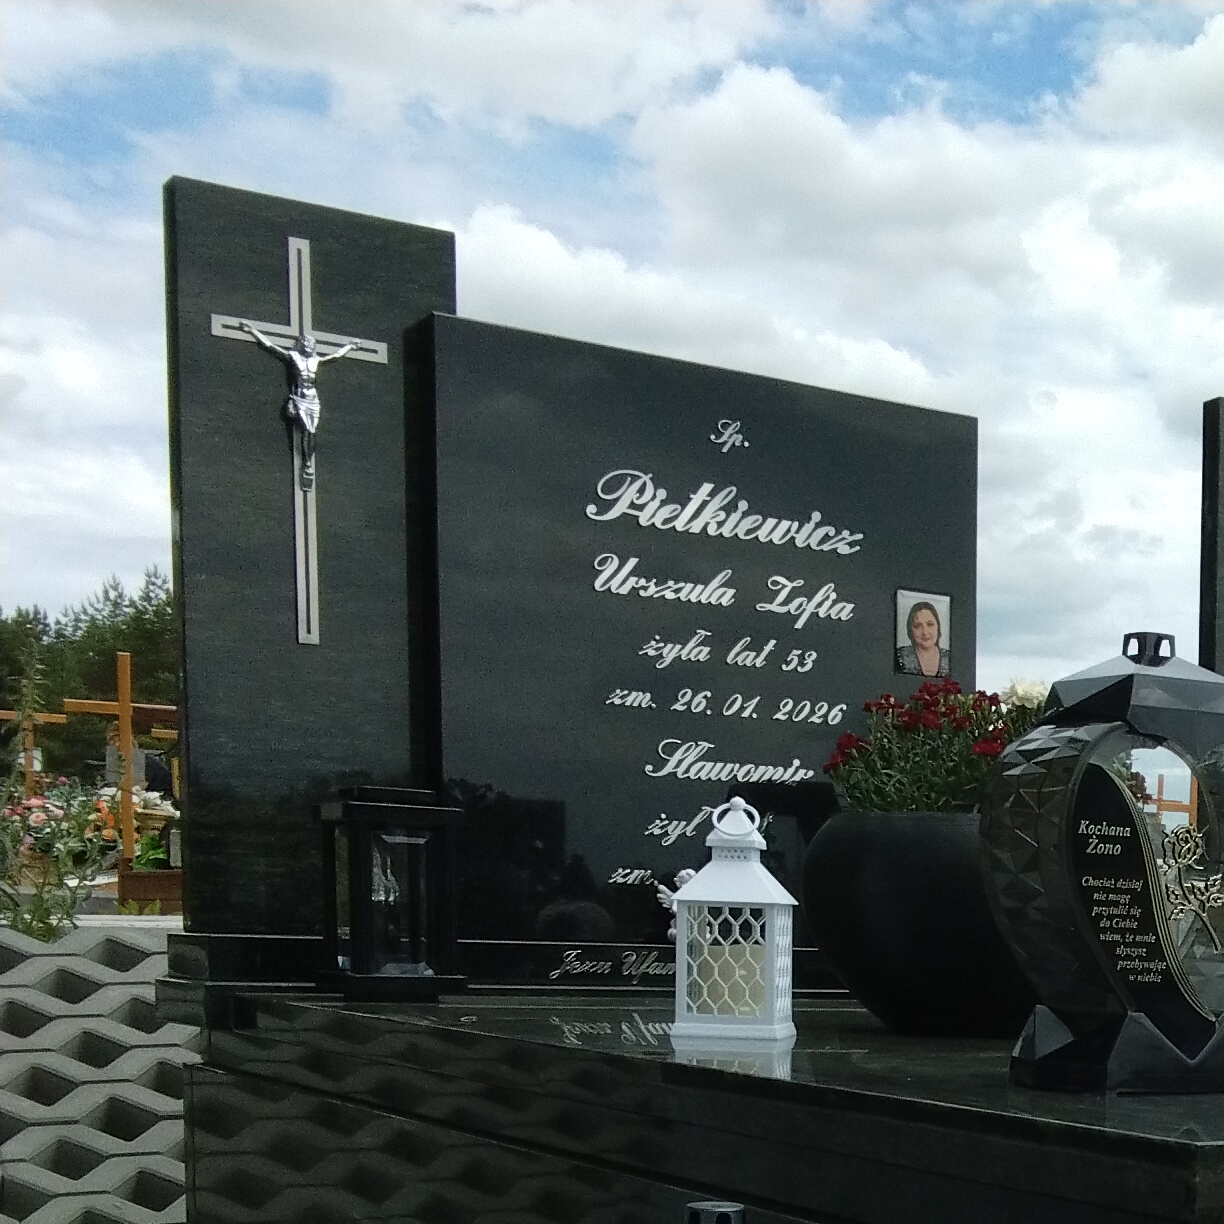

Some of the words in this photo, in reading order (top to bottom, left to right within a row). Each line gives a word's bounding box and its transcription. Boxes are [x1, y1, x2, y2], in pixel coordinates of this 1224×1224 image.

[585, 468, 865, 556] Pietkiewicz
[593, 552, 738, 607] Urszula
[755, 574, 856, 629] Zofia
[638, 629, 711, 668] żyła
[726, 636, 775, 668] lat
[781, 648, 818, 673] 53
[606, 687, 657, 710] zm.
[670, 688, 712, 716] 26.
[722, 693, 759, 720] 01.
[773, 699, 847, 726] 2026
[645, 738, 815, 785] Sławomir
[1078, 819, 1131, 838] Kochana
[1086, 836, 1122, 856] Żono
[1093, 891, 1107, 902] nie
[1108, 893, 1131, 904] mogę
[1100, 918, 1111, 928] do
[1112, 919, 1139, 930] Ciebie
